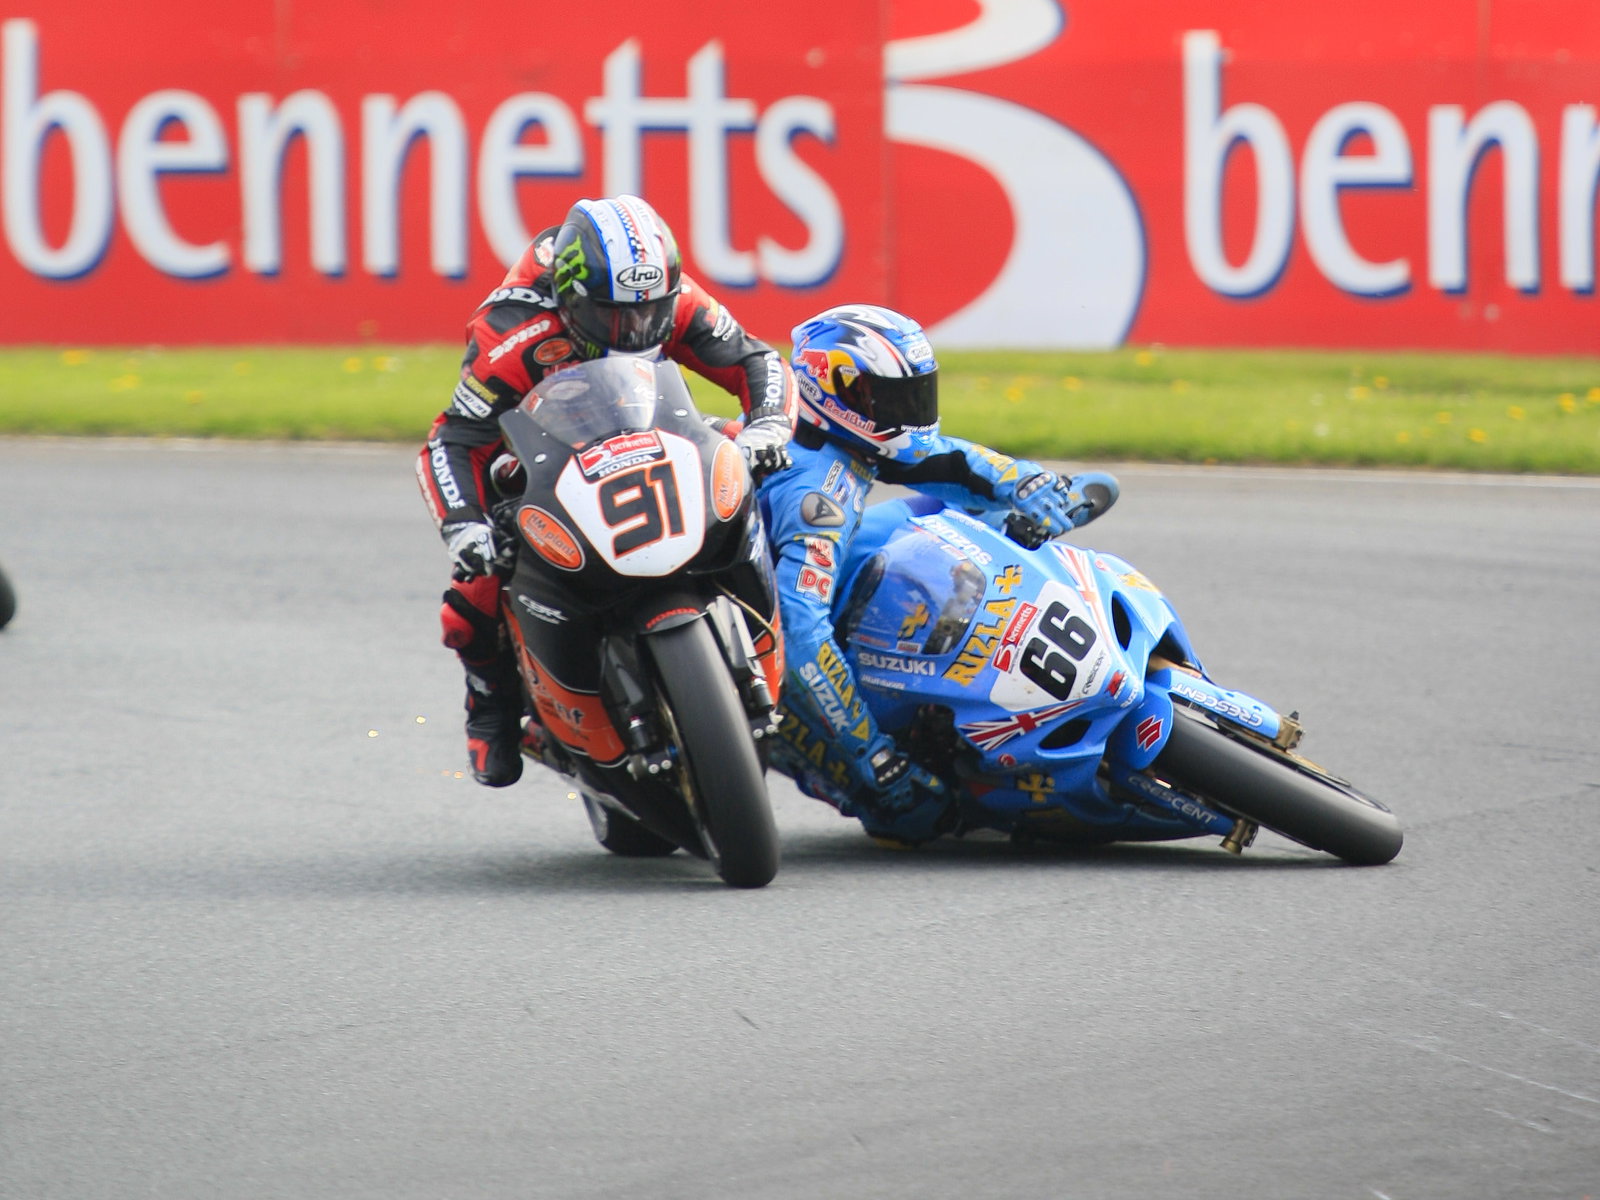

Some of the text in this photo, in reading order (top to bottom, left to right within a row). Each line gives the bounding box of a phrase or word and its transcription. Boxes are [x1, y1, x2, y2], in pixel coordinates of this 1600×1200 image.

[0, 18, 845, 288] bennetts
[618, 267, 659, 283] Arai
[598, 455, 656, 477] HONDA
[598, 460, 686, 559] 91
[528, 513, 547, 530] HM
[545, 531, 576, 556] plant
[646, 607, 699, 629] HONDA
[1006, 605, 1033, 642] bennetts
[858, 652, 936, 677] SUZUKI
[1020, 601, 1097, 701] 66
[1172, 682, 1263, 727] CRESCENT
[1128, 775, 1218, 825] CRESCENT
